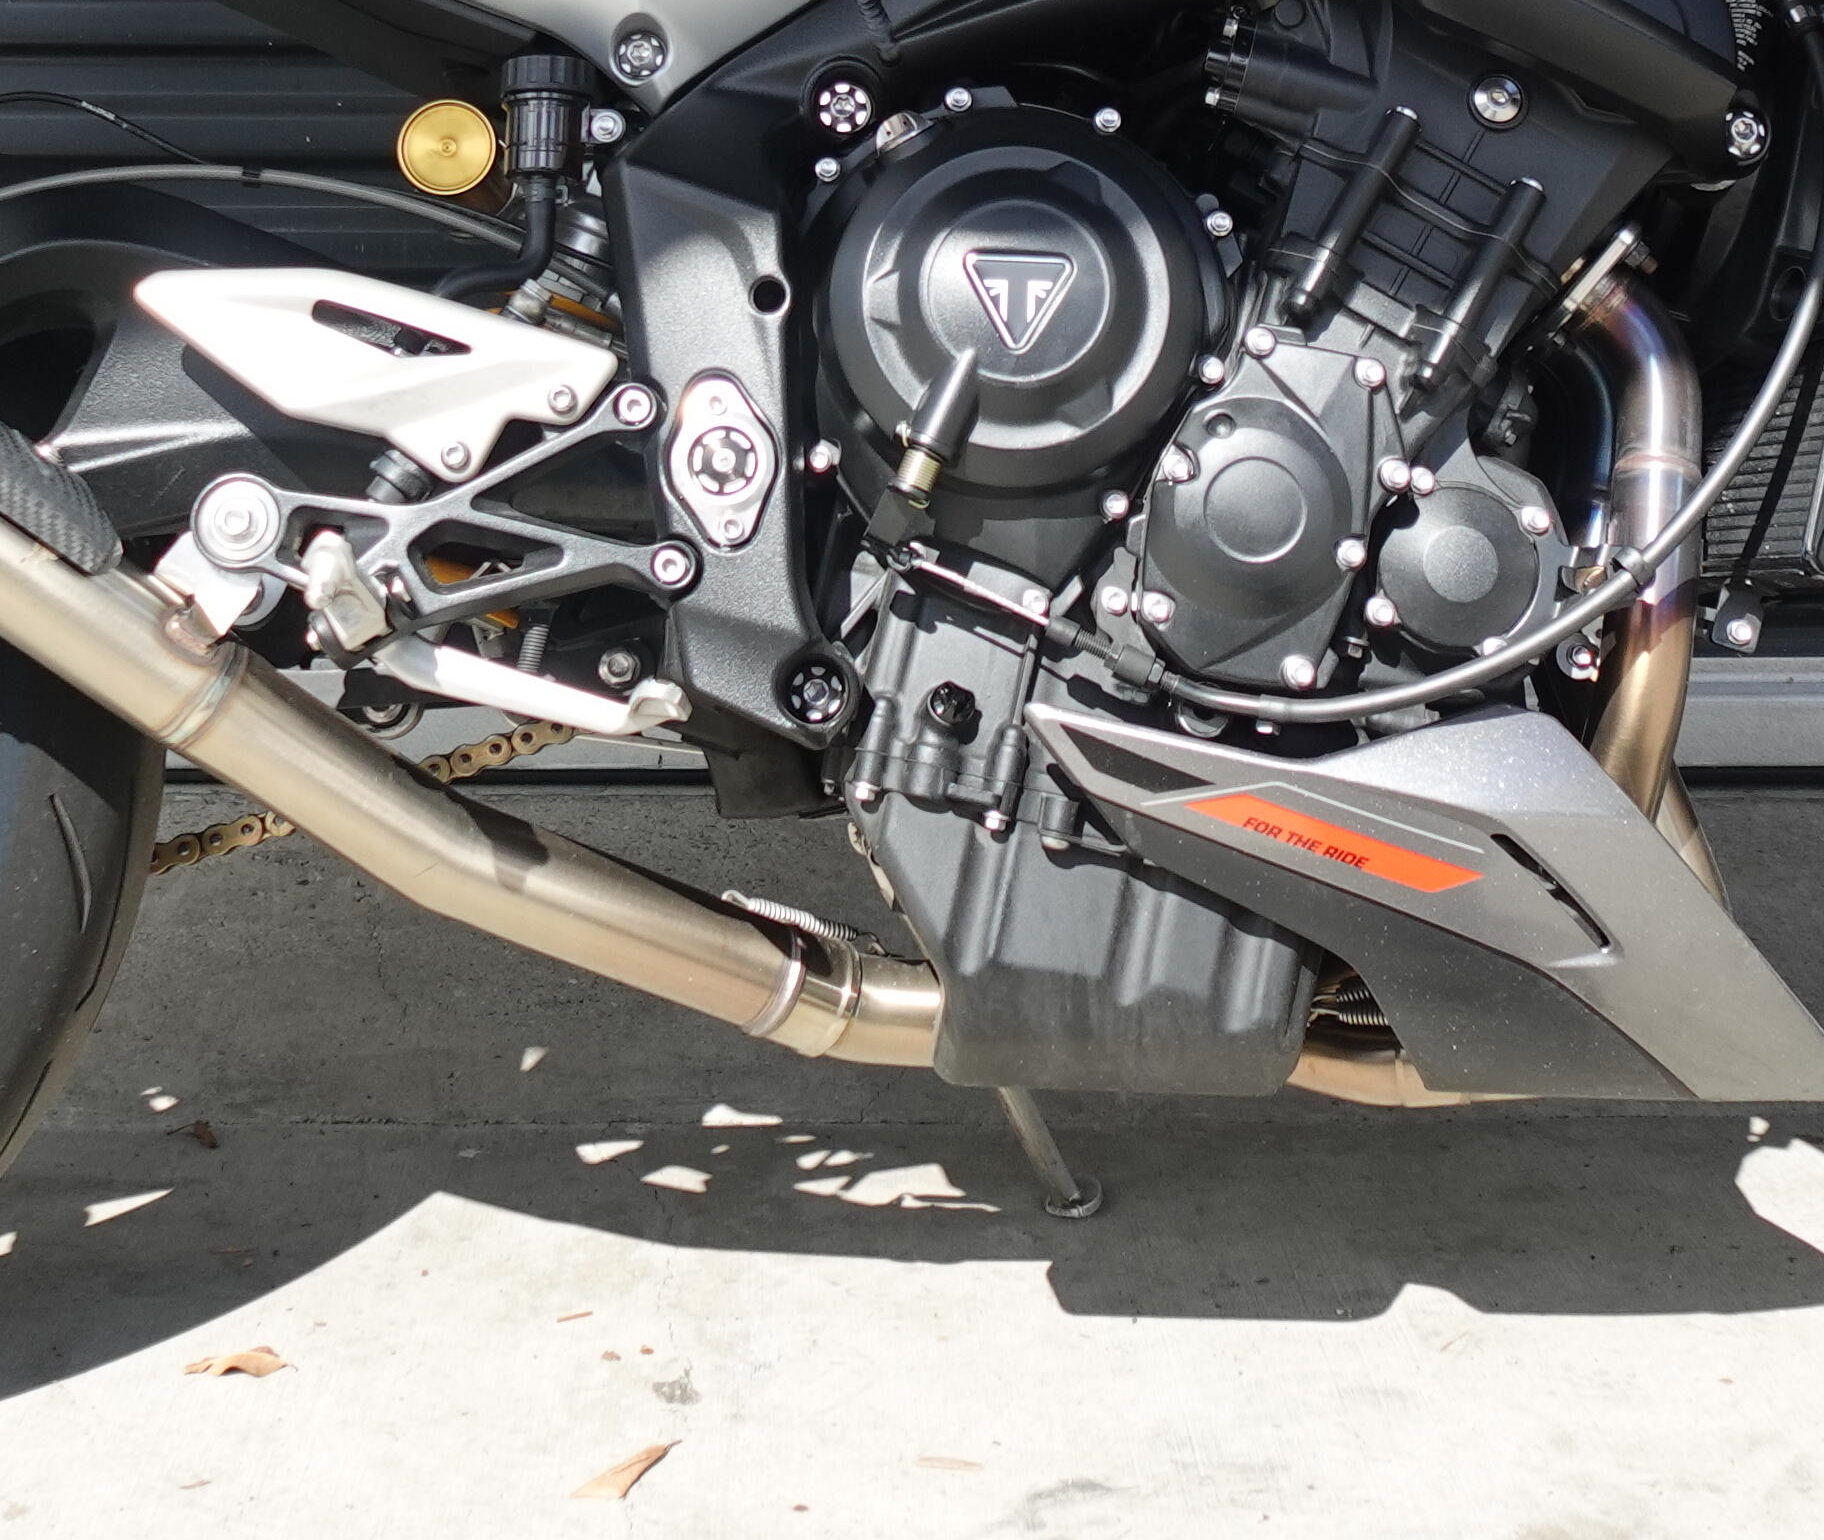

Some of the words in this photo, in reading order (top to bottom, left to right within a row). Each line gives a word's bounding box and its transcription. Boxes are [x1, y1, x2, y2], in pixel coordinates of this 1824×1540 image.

[1242, 816, 1283, 839] FOR
[1286, 830, 1323, 853] THE
[1322, 845, 1372, 869] RIDE
